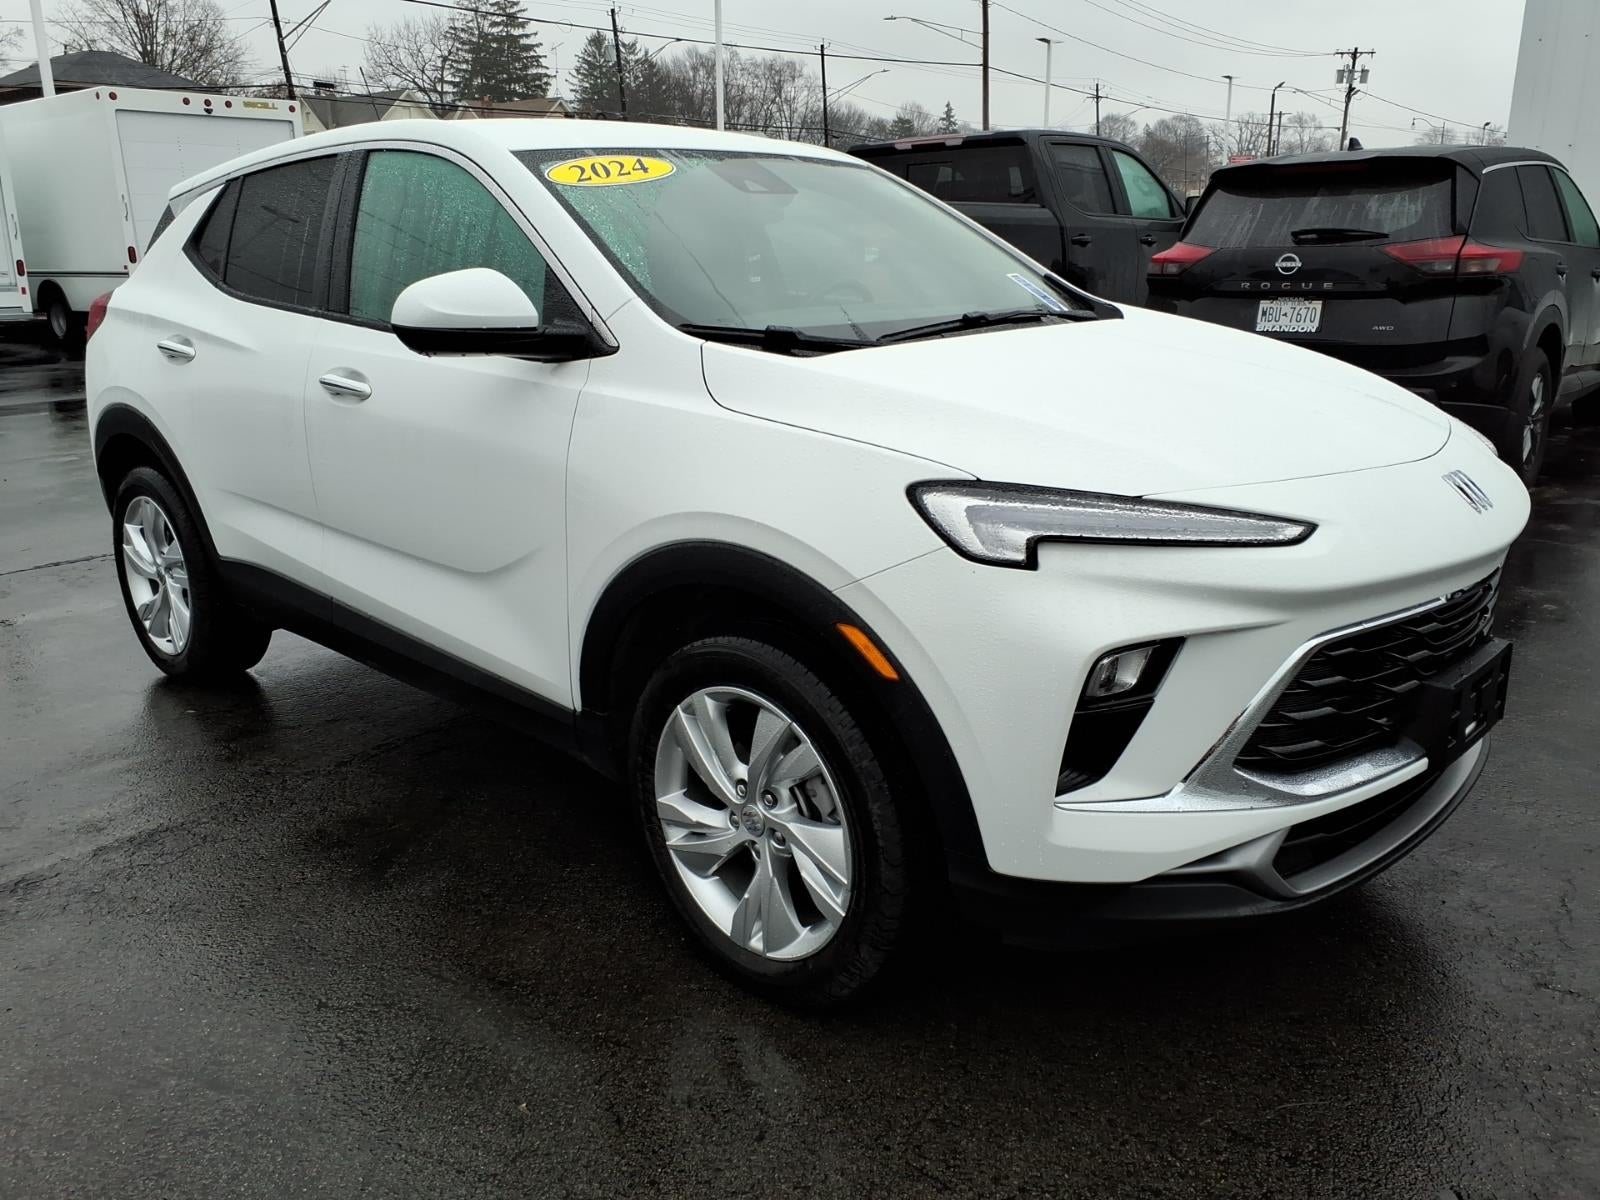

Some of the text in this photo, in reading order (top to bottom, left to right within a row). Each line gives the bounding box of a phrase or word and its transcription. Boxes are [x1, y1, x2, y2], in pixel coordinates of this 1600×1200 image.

[568, 158, 650, 183] 2024
[1240, 282, 1334, 290] ROGUE
[1255, 324, 1317, 333] BRANDON
